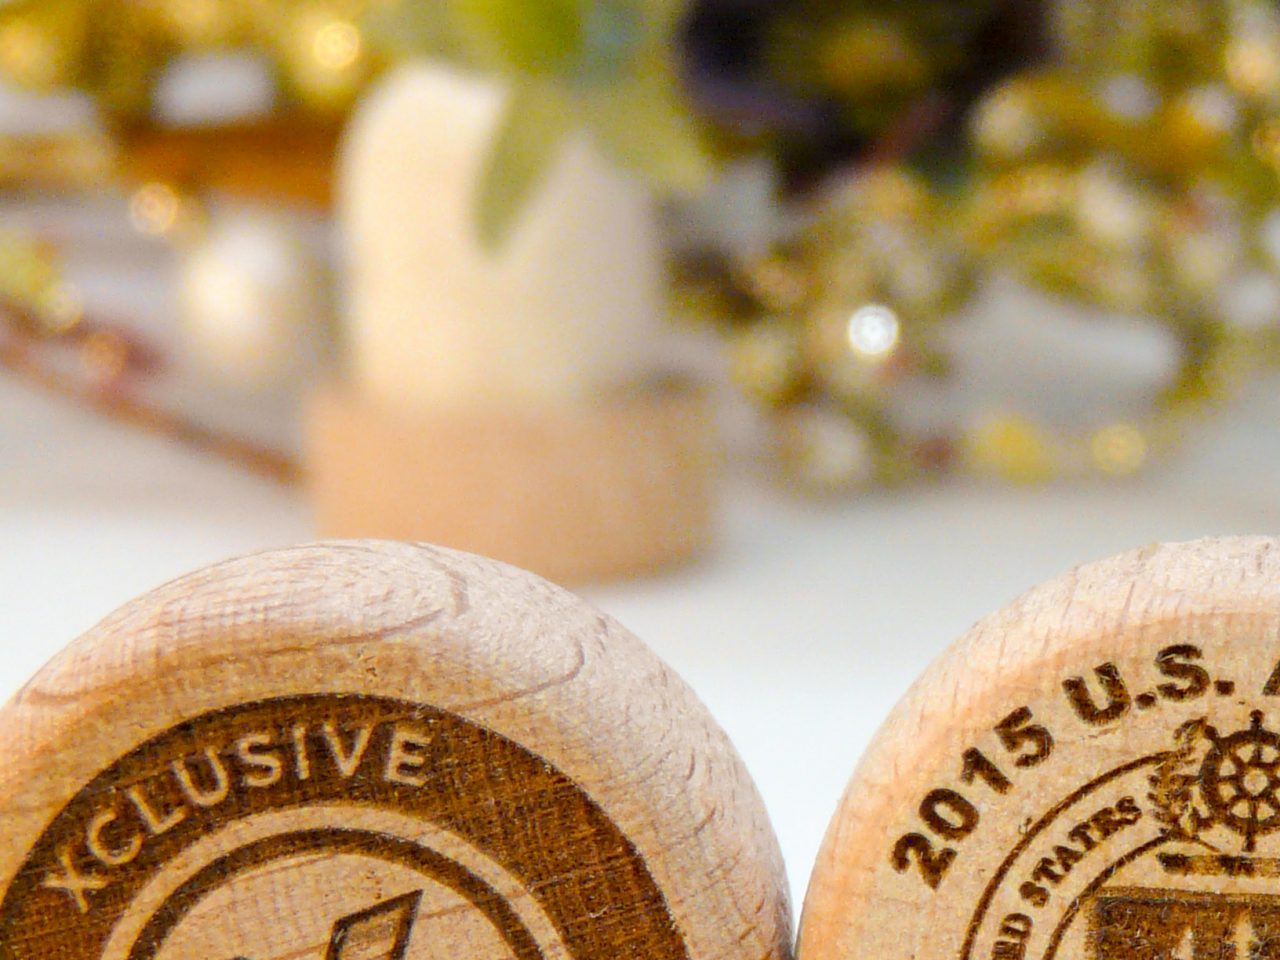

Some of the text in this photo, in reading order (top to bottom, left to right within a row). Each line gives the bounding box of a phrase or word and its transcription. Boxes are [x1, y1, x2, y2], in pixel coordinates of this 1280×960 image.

[40, 720, 432, 912] XCLUSIVE
[890, 705, 1055, 890] 2015
[1061, 642, 1235, 725] U.S.
[1019, 796, 1143, 908] STATES
